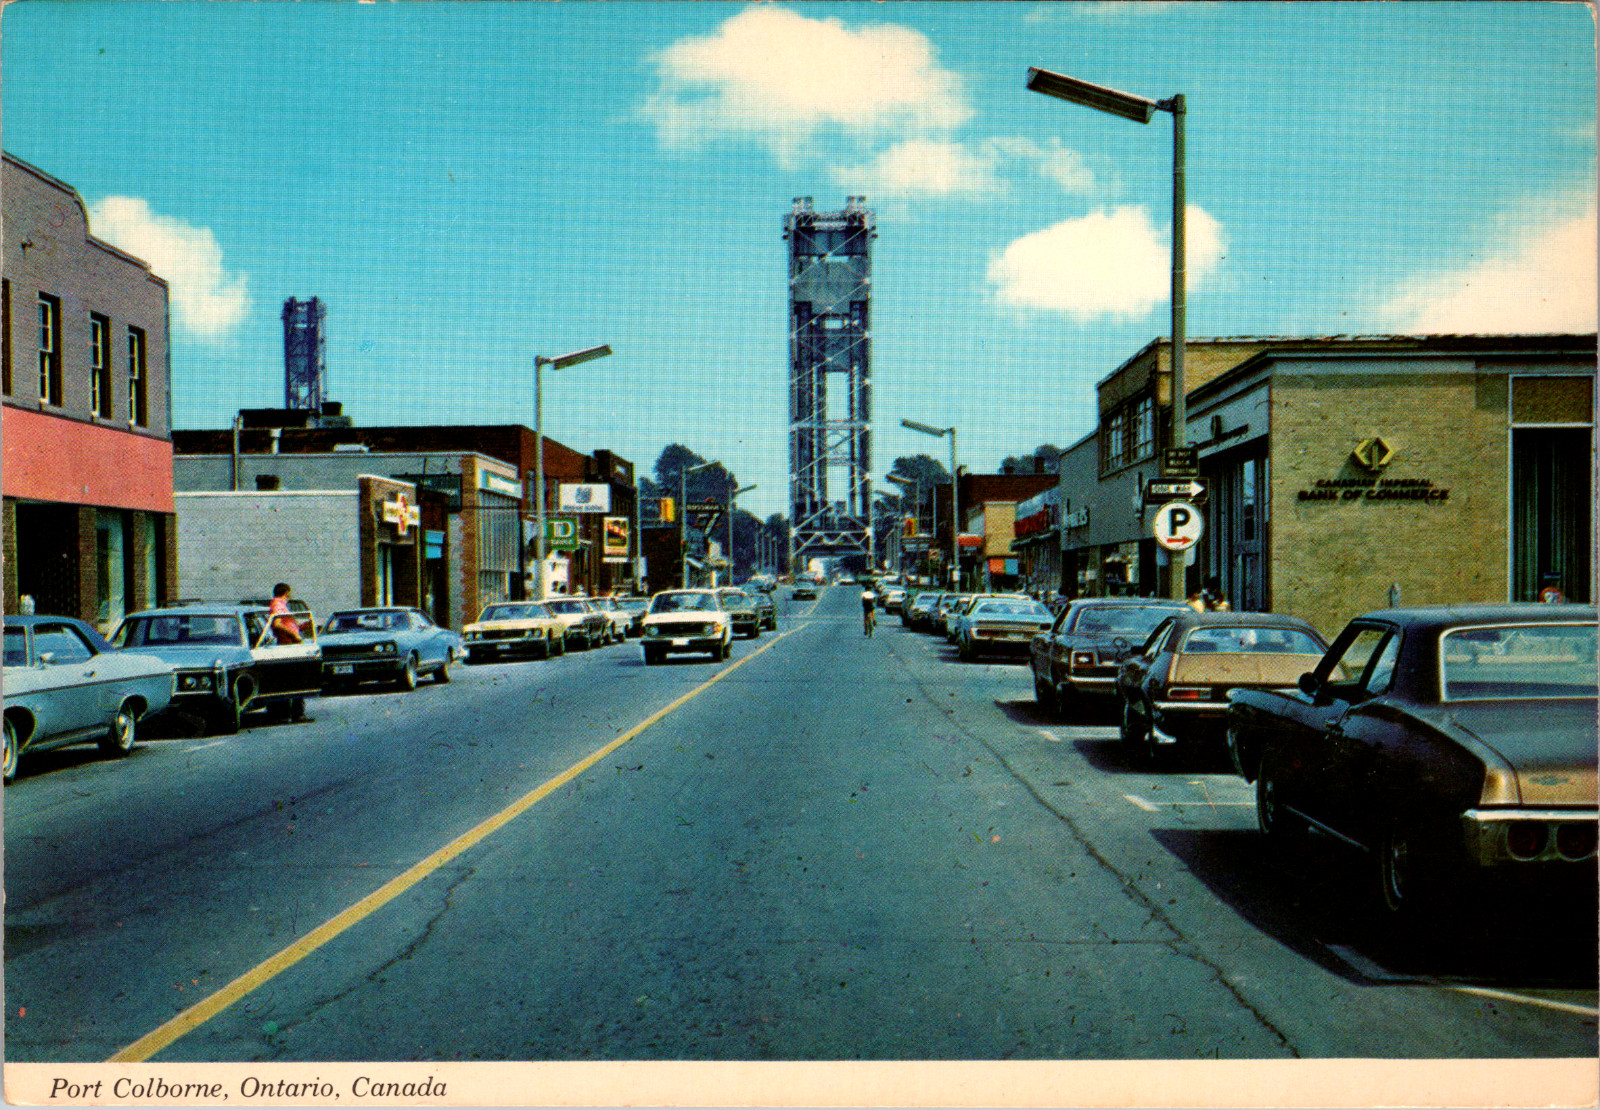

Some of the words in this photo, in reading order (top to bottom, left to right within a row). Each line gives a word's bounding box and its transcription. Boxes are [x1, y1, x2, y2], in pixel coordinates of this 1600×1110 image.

[1316, 479, 1375, 487] CANADIAN
[1380, 479, 1433, 487] IMPERIAL
[1152, 485, 1169, 493] ONE
[1174, 485, 1191, 493] WAY
[1298, 490, 1338, 500] BANK
[1342, 490, 1363, 500] OF
[1366, 489, 1449, 500] COMMERCE
[1169, 508, 1190, 536] P
[548, 521, 575, 538] TD
